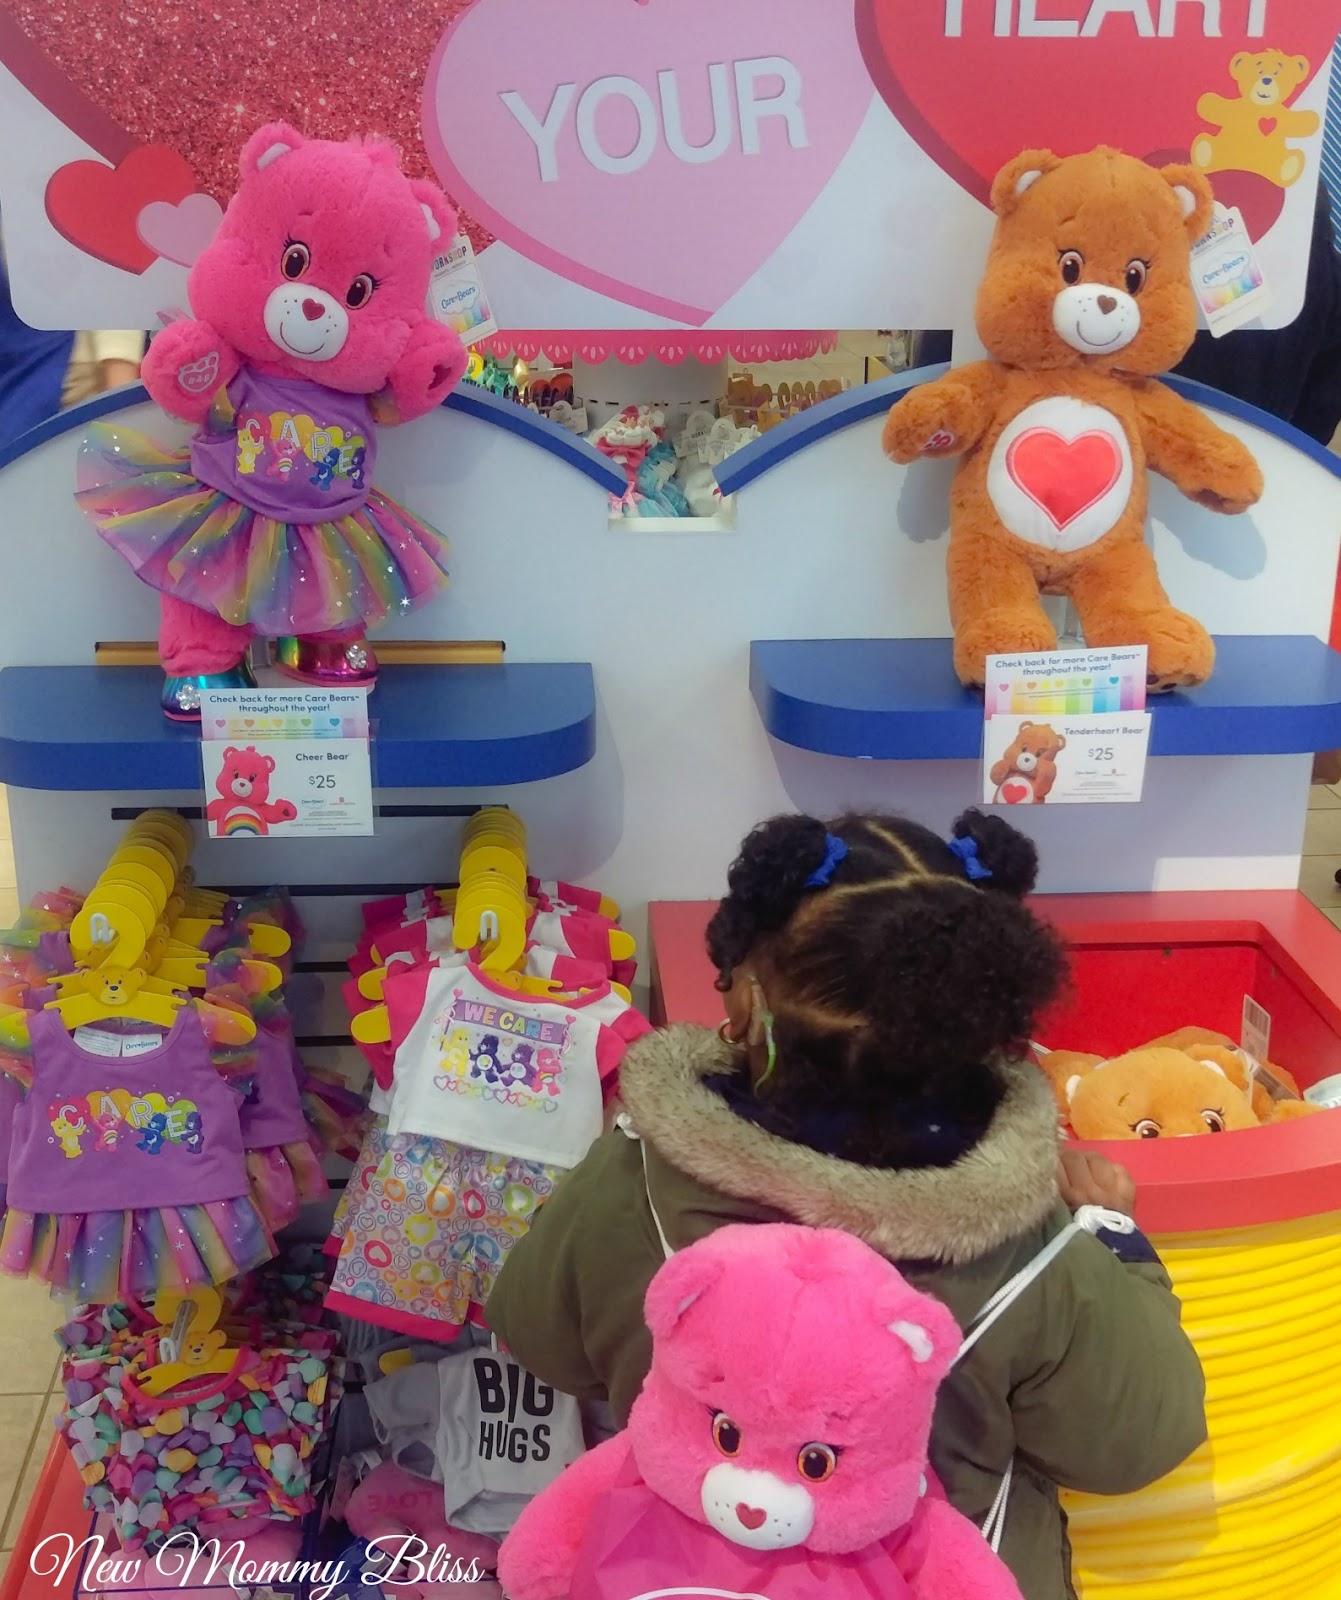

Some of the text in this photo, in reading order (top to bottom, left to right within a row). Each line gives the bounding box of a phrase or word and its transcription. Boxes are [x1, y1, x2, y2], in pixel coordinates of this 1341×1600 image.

[499, 56, 810, 183] YOUR
[441, 286, 476, 309] Care Bears
[245, 418, 356, 474] CARE
[995, 660, 1023, 669] Check
[1024, 658, 1046, 667] back
[1048, 657, 1061, 666] for
[1062, 657, 1085, 665] more
[1087, 654, 1109, 663] Care
[1022, 663, 1112, 677] throughout the year!
[209, 695, 237, 703] Check
[240, 694, 262, 703] back
[264, 694, 277, 703] for
[279, 695, 302, 703] more
[304, 694, 327, 703] Care
[238, 704, 330, 714] throughout the year!
[1064, 727, 1144, 736] Tenderheart Bear
[295, 752, 349, 762] Cheer Bear
[1088, 747, 1114, 761] $25
[309, 774, 336, 789] $25
[464, 1001, 554, 1041] WE CARE
[58, 1095, 184, 1138] CARE
[473, 1357, 554, 1423] BIG
[478, 1420, 551, 1463] HUGS
